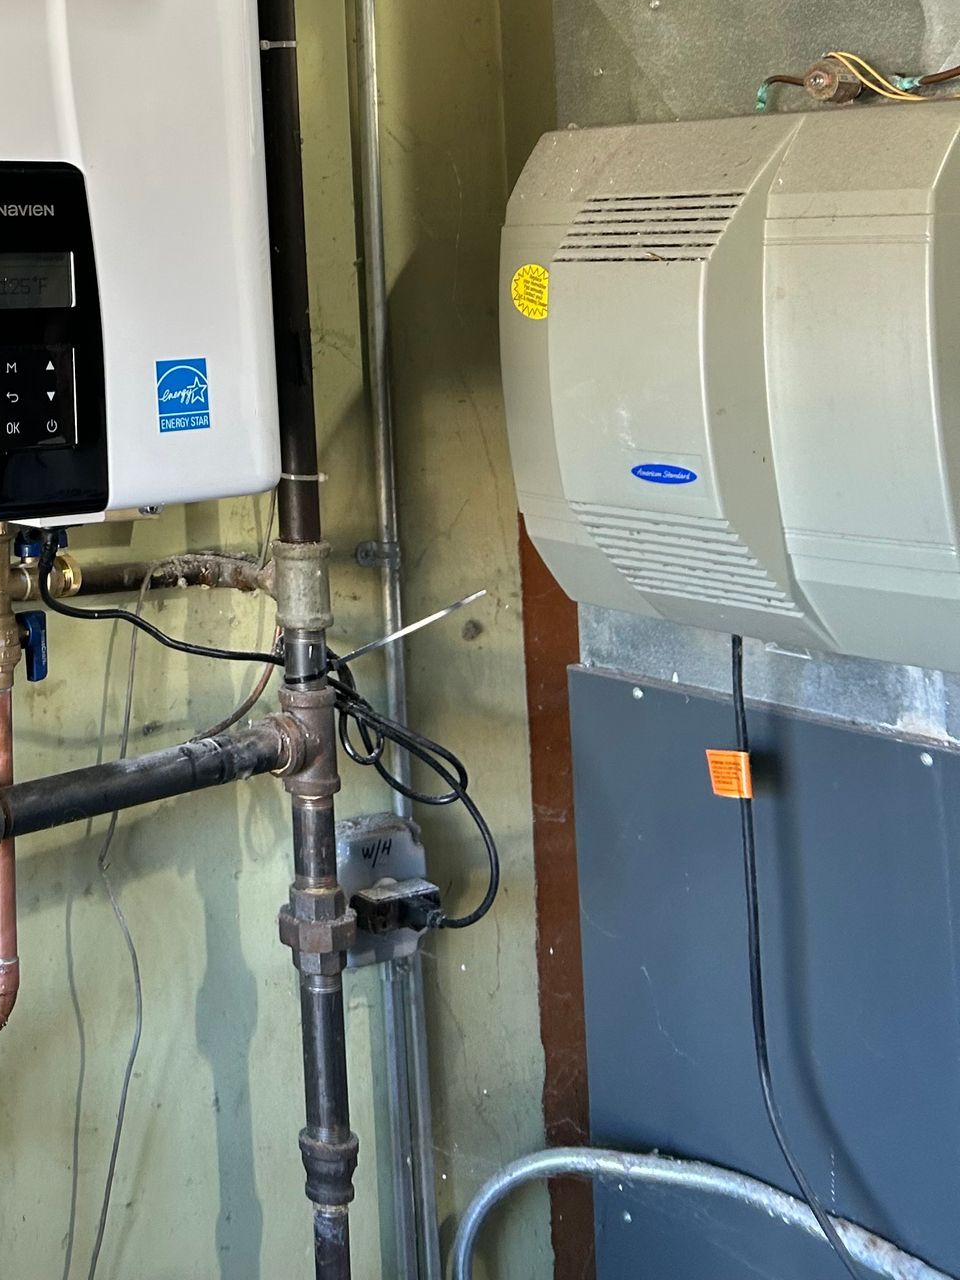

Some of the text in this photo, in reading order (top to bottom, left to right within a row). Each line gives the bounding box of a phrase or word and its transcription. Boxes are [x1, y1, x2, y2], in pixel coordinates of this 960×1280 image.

[6, 362, 17, 374] M
[6, 421, 20, 434] OK
[161, 415, 209, 430] ENERGY STAR
[636, 468, 691, 480] American Standard
